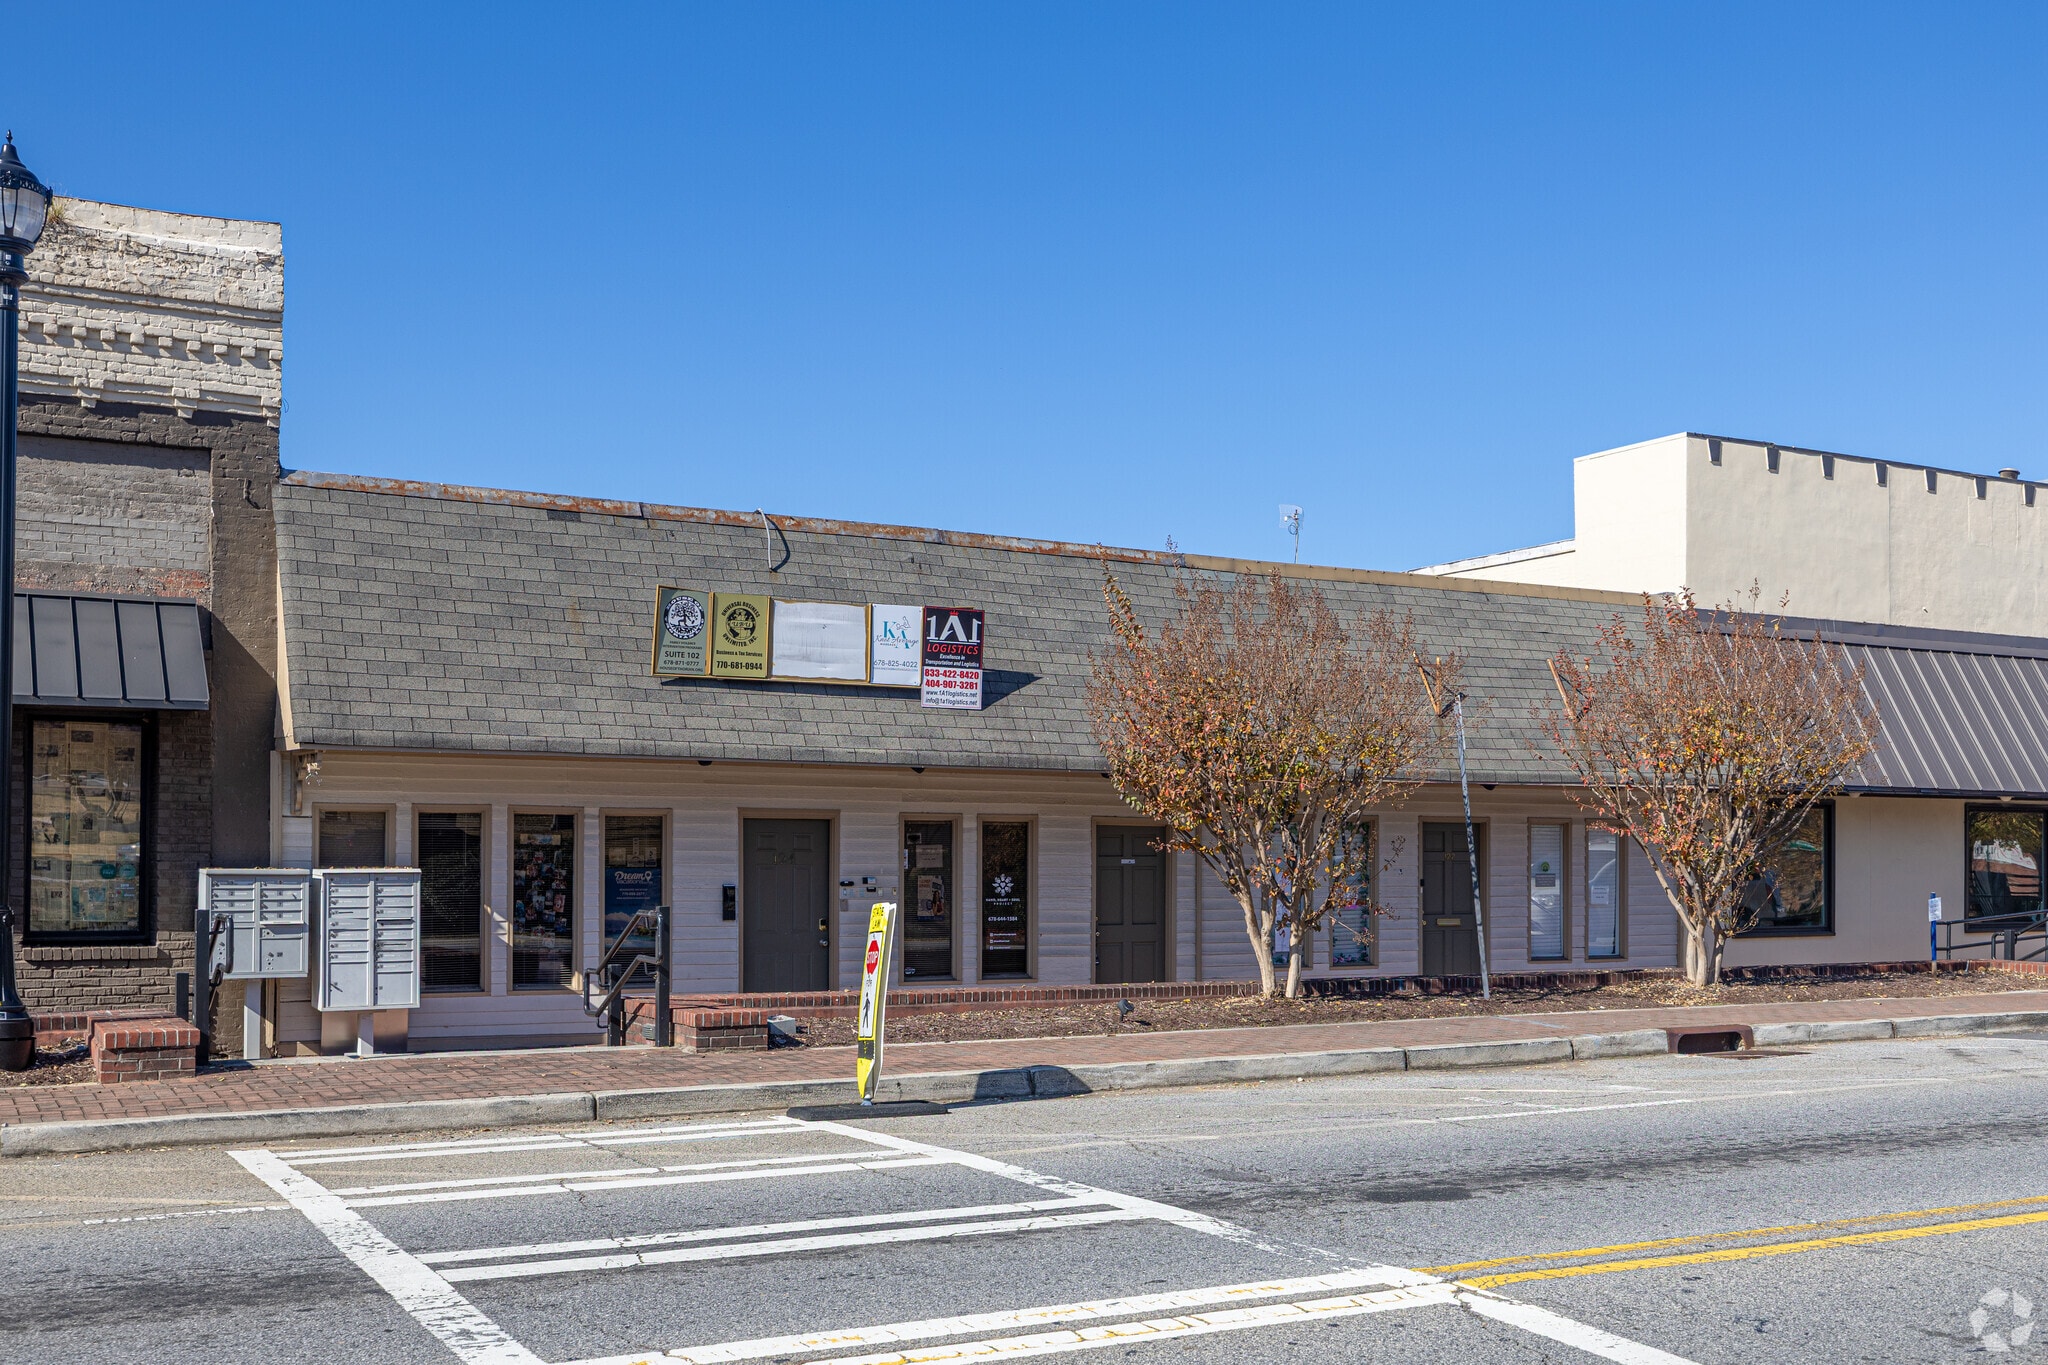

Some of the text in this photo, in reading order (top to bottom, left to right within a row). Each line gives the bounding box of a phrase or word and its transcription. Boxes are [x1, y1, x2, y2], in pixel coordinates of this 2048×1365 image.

[721, 601, 760, 617] UNIVERSAL BUSINESS
[926, 614, 982, 643] 1A1
[664, 650, 685, 659] SUITE
[927, 643, 979, 655] LOGISTICS
[716, 660, 763, 670] 770-681-0944
[874, 660, 918, 668] 678-825-4022
[924, 669, 980, 680] 833-422-8420
[925, 679, 978, 690] 404-907-3281
[614, 871, 645, 880] Dream
[866, 951, 879, 964] STOP
